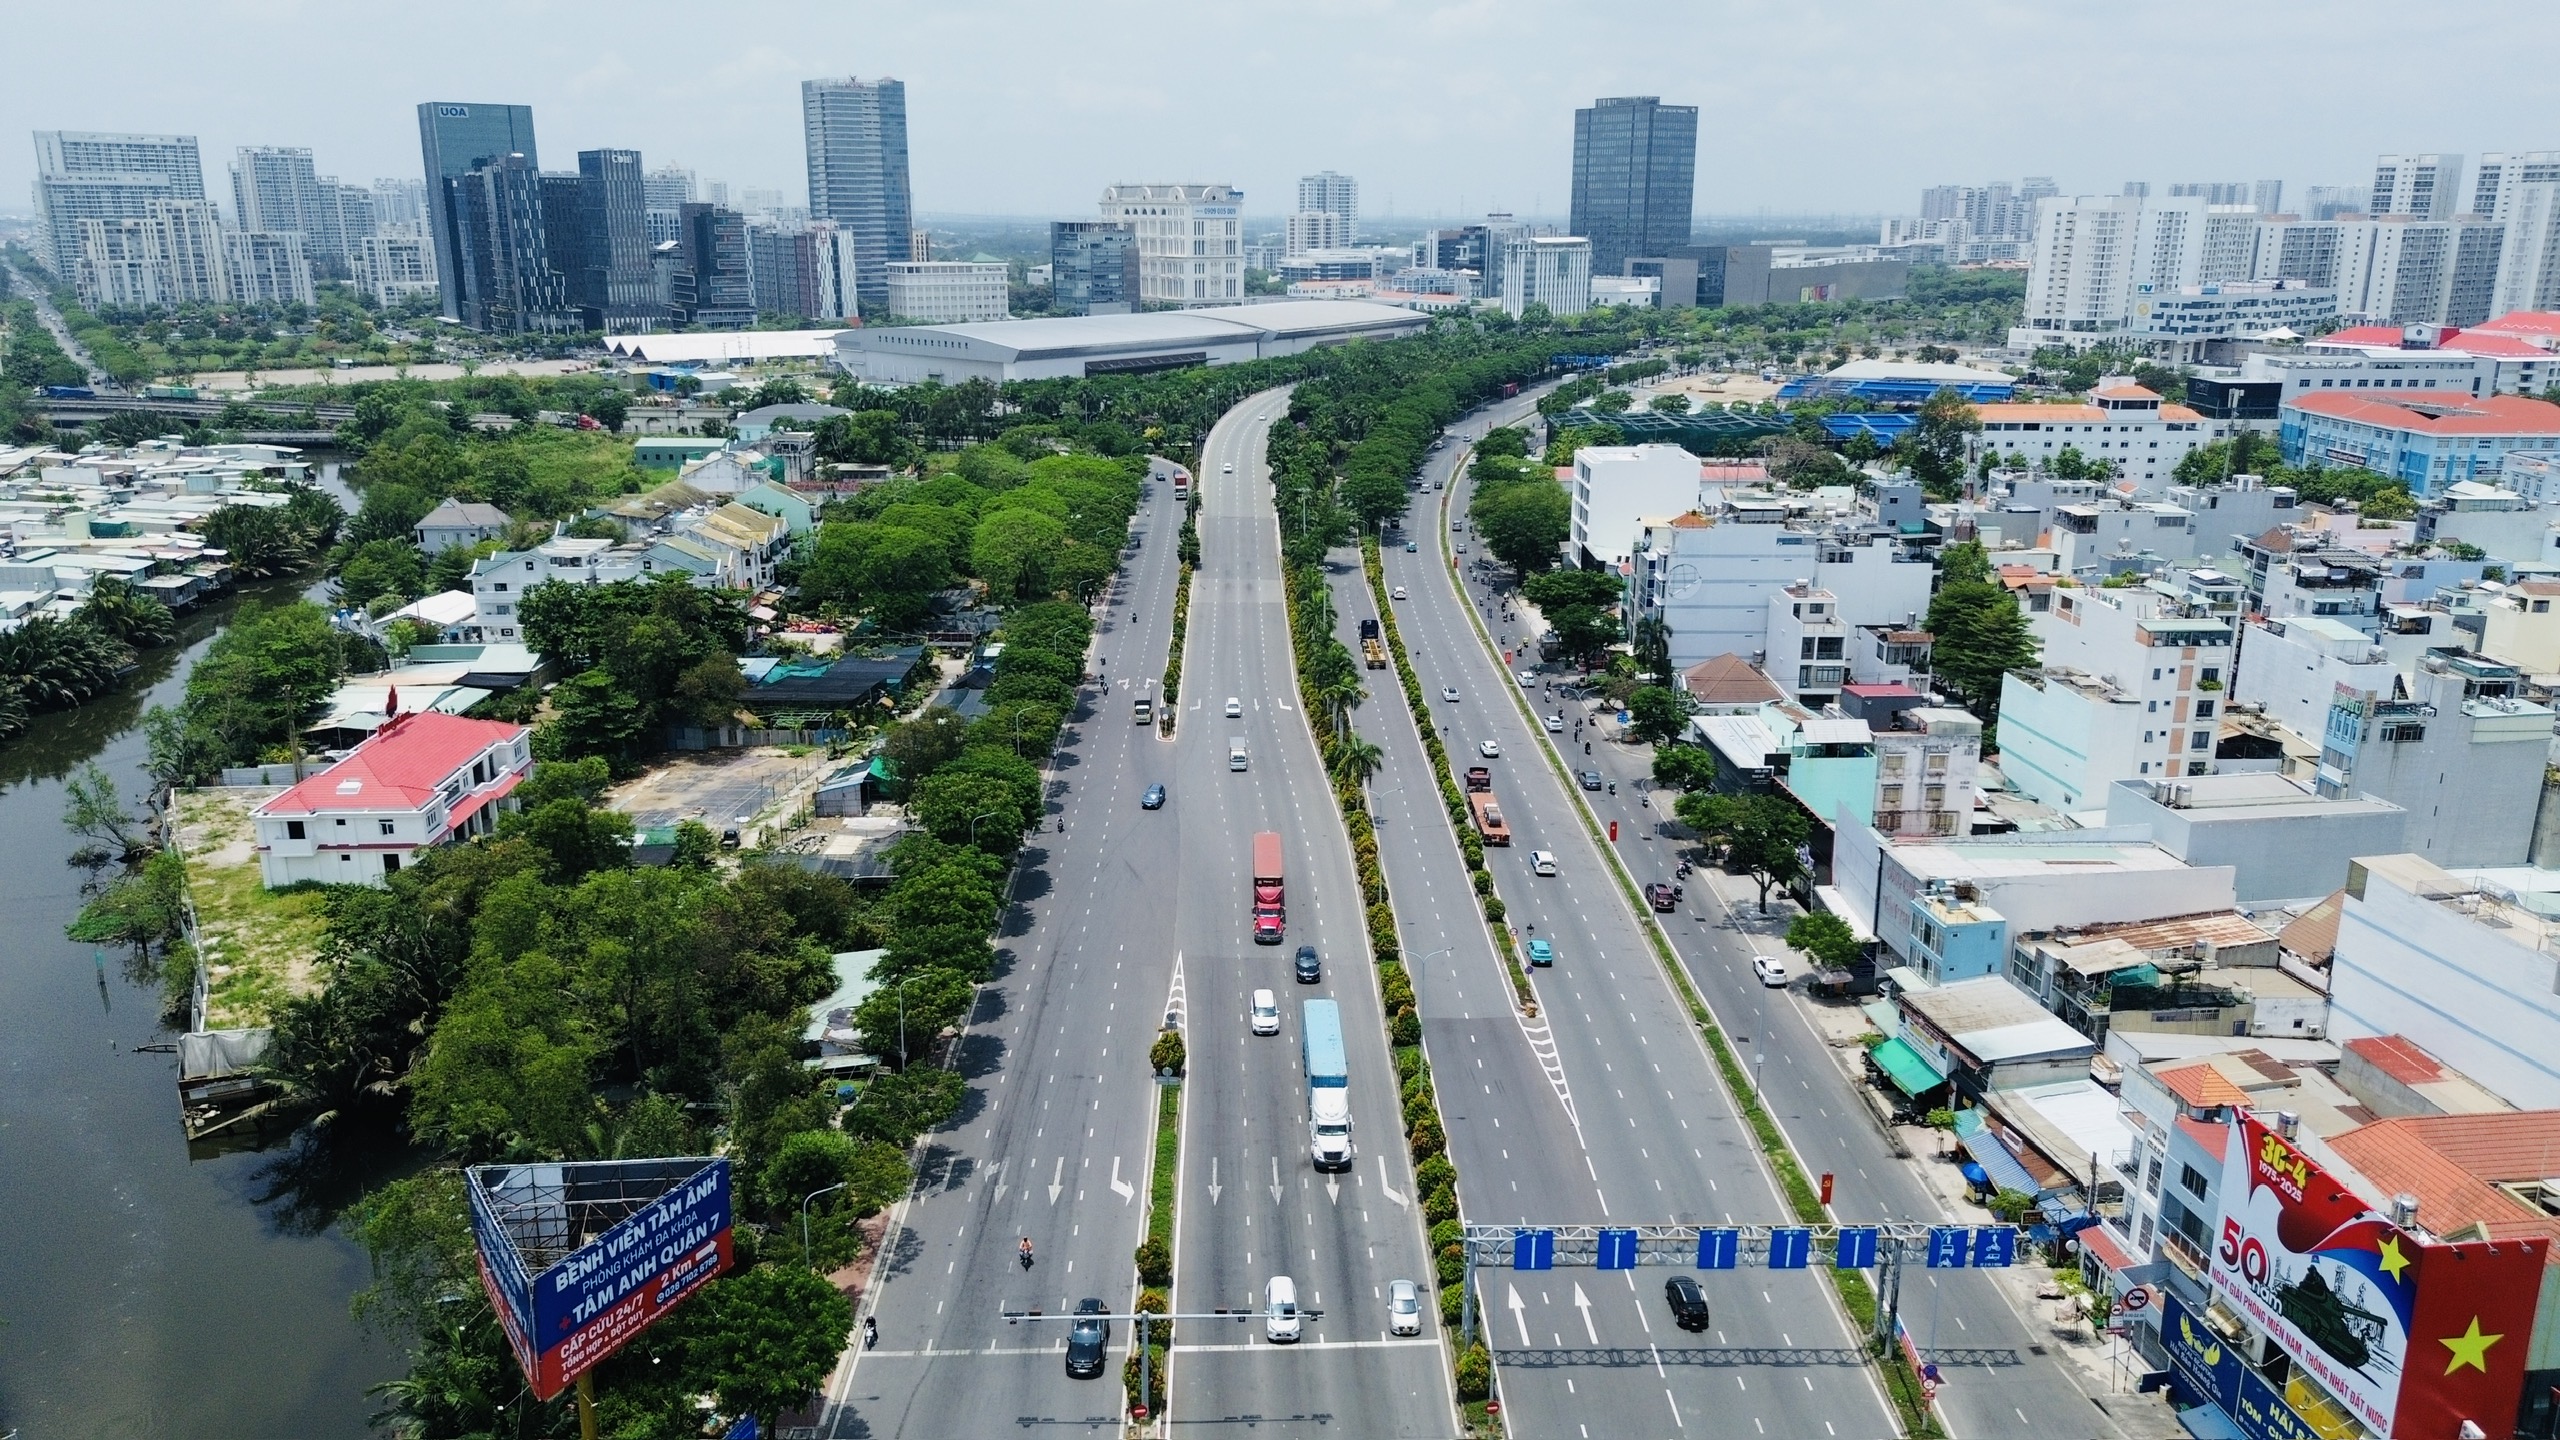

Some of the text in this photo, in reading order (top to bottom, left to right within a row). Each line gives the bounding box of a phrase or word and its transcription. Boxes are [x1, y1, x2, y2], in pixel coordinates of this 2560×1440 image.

[439, 107, 467, 117] UOA
[555, 1248, 604, 1293] BỆNH
[606, 1221, 646, 1258] VIỆN
[572, 1211, 720, 1324] TÂM ANH QUẬN 7
[582, 1210, 698, 1294] PHÒNG KHÁM ĐA KHOA
[660, 1259, 692, 1289] 2 Km
[2218, 1213, 2271, 1285] 50
[664, 1253, 718, 1297] 028 7102 6789
[2250, 1278, 2283, 1317] năm
[560, 1292, 644, 1359] CẤP CỨU 24/7
[561, 1350, 585, 1371] TỔNG
[585, 1337, 603, 1355] HỢP
[610, 1320, 627, 1338] ĐỘT
[2241, 1396, 2262, 1425] TÔM
[2304, 1349, 2329, 1381] THỐNG
[2328, 1371, 2350, 1399] NHẤT
[2365, 1404, 2388, 1434] NƯỚC
[2269, 1401, 2294, 1436] HẢI
